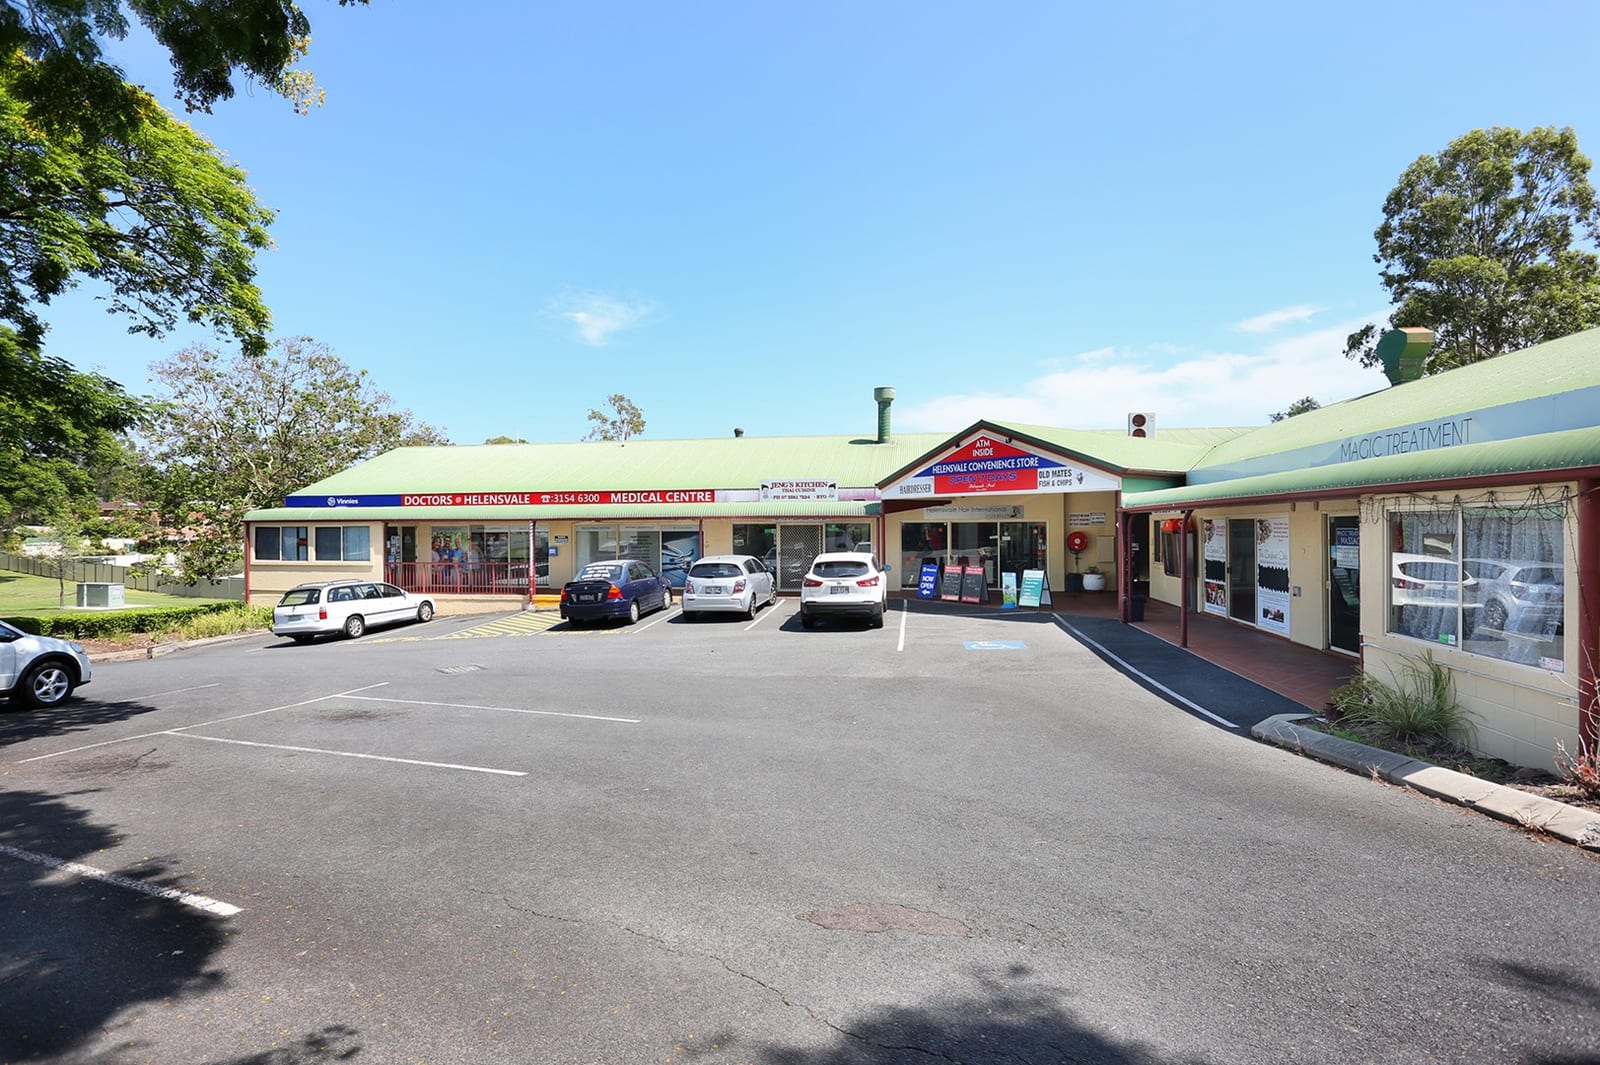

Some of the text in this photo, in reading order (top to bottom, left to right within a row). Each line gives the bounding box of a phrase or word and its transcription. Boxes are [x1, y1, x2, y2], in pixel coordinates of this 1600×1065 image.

[975, 440, 990, 448] ATM
[1341, 418, 1472, 461] MAGIC TREATMENT
[972, 448, 994, 457] INSIDE
[932, 457, 1039, 474] HELENSVALE CONVENIENCE STORE
[950, 471, 1017, 484] OPEN 7 DAYS
[1039, 469, 1072, 479] OLD MATES
[1056, 479, 1072, 487] CHIPS
[899, 484, 931, 494] HAIRDRESSER
[404, 495, 453, 506] DOCTORS
[464, 494, 530, 505] HELENSVALE
[577, 493, 600, 503] 6300
[610, 492, 663, 503] MEDICAL
[665, 491, 712, 503] CENTRE
[971, 505, 1007, 513] International
